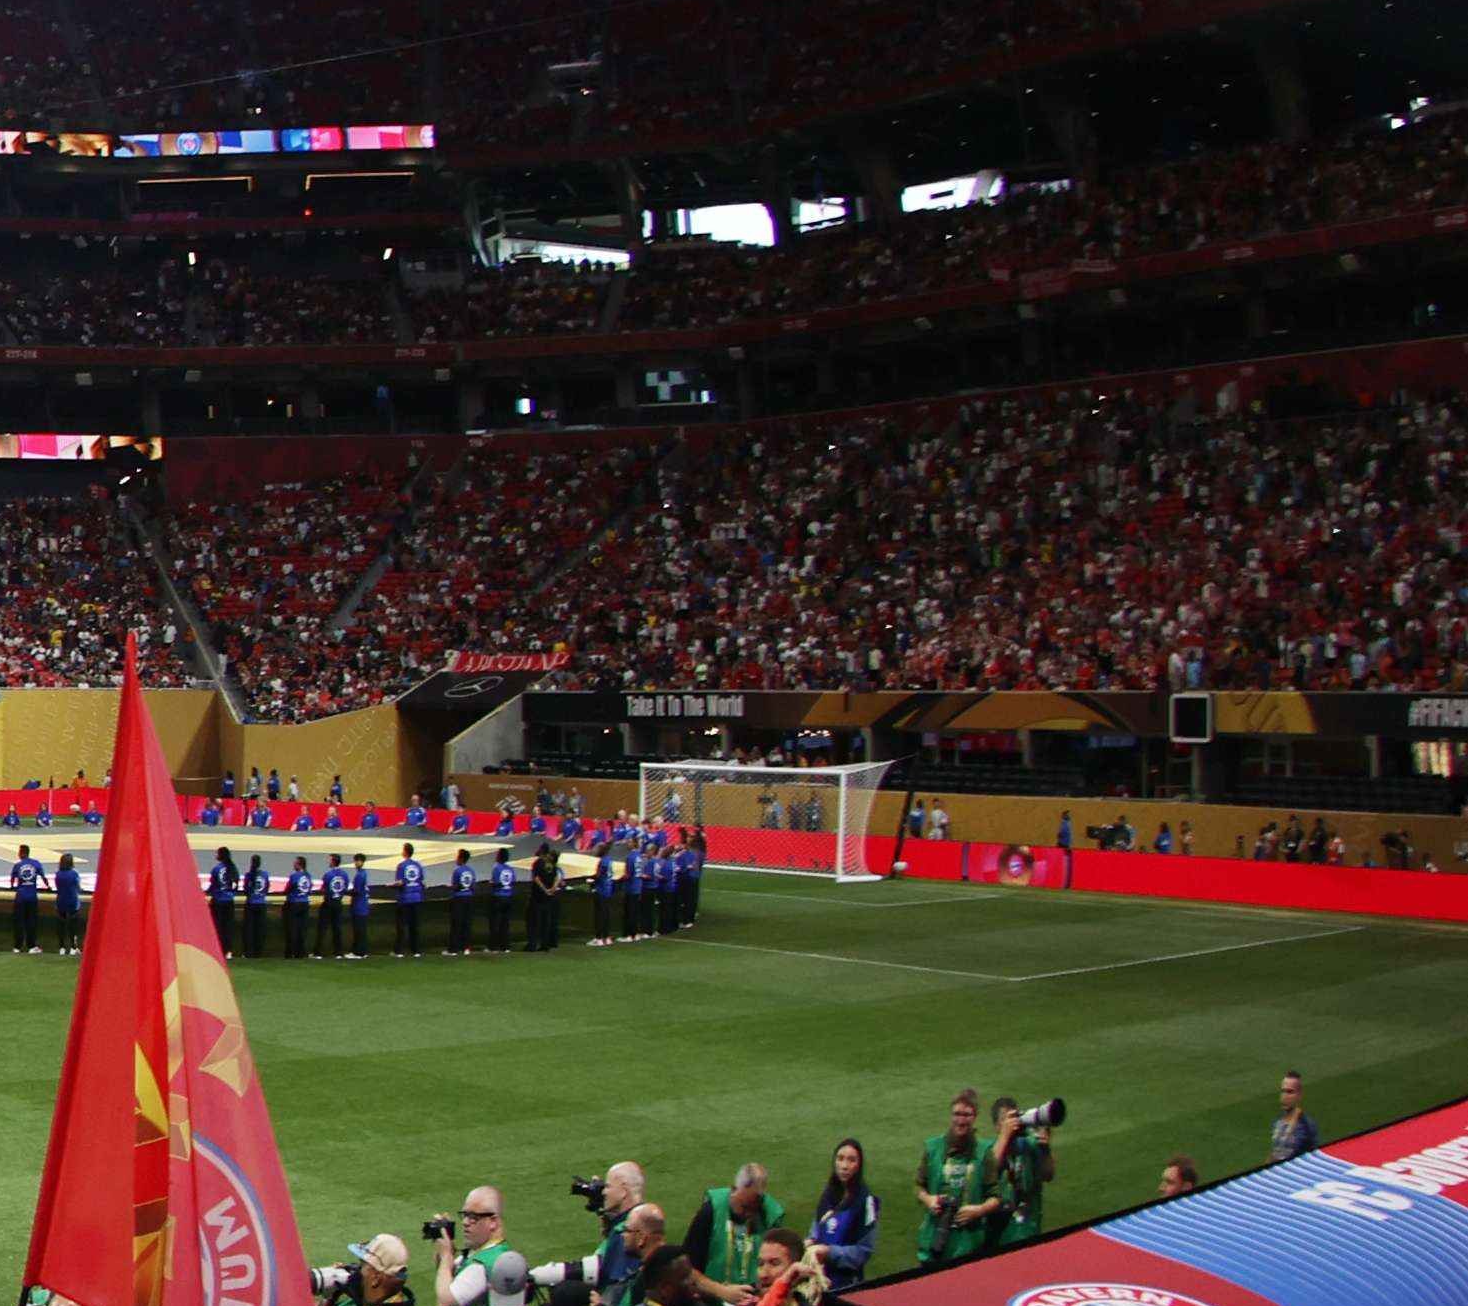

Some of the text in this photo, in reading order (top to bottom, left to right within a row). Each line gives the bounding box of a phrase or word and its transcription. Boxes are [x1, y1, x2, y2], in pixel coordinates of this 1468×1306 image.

[626, 694, 744, 716] Take It To The World
[1296, 1181, 1413, 1221] FC
